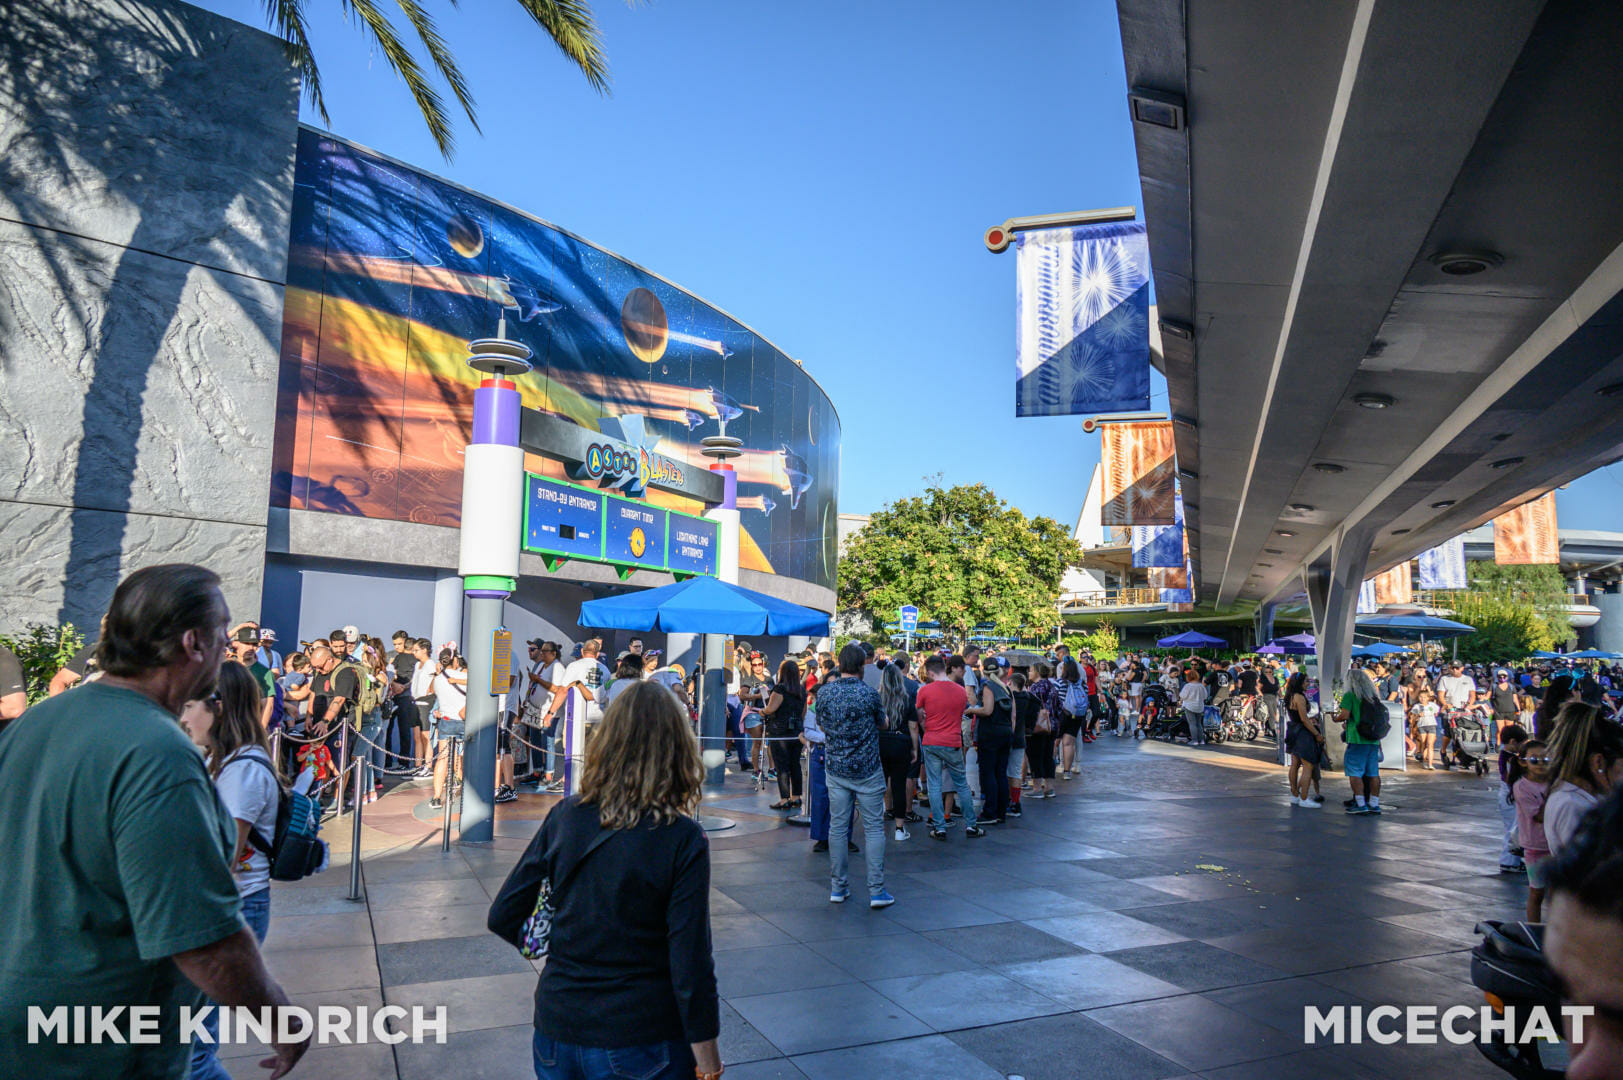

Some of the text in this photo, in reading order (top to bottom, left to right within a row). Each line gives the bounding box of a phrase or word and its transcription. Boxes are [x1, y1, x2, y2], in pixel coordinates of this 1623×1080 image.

[1037, 244, 1062, 407] TOMORROWLAND
[588, 445, 636, 475] ASTRO
[537, 487, 597, 512] STAND-BY ENTRANCE
[620, 507, 654, 524] CURRENT TIME
